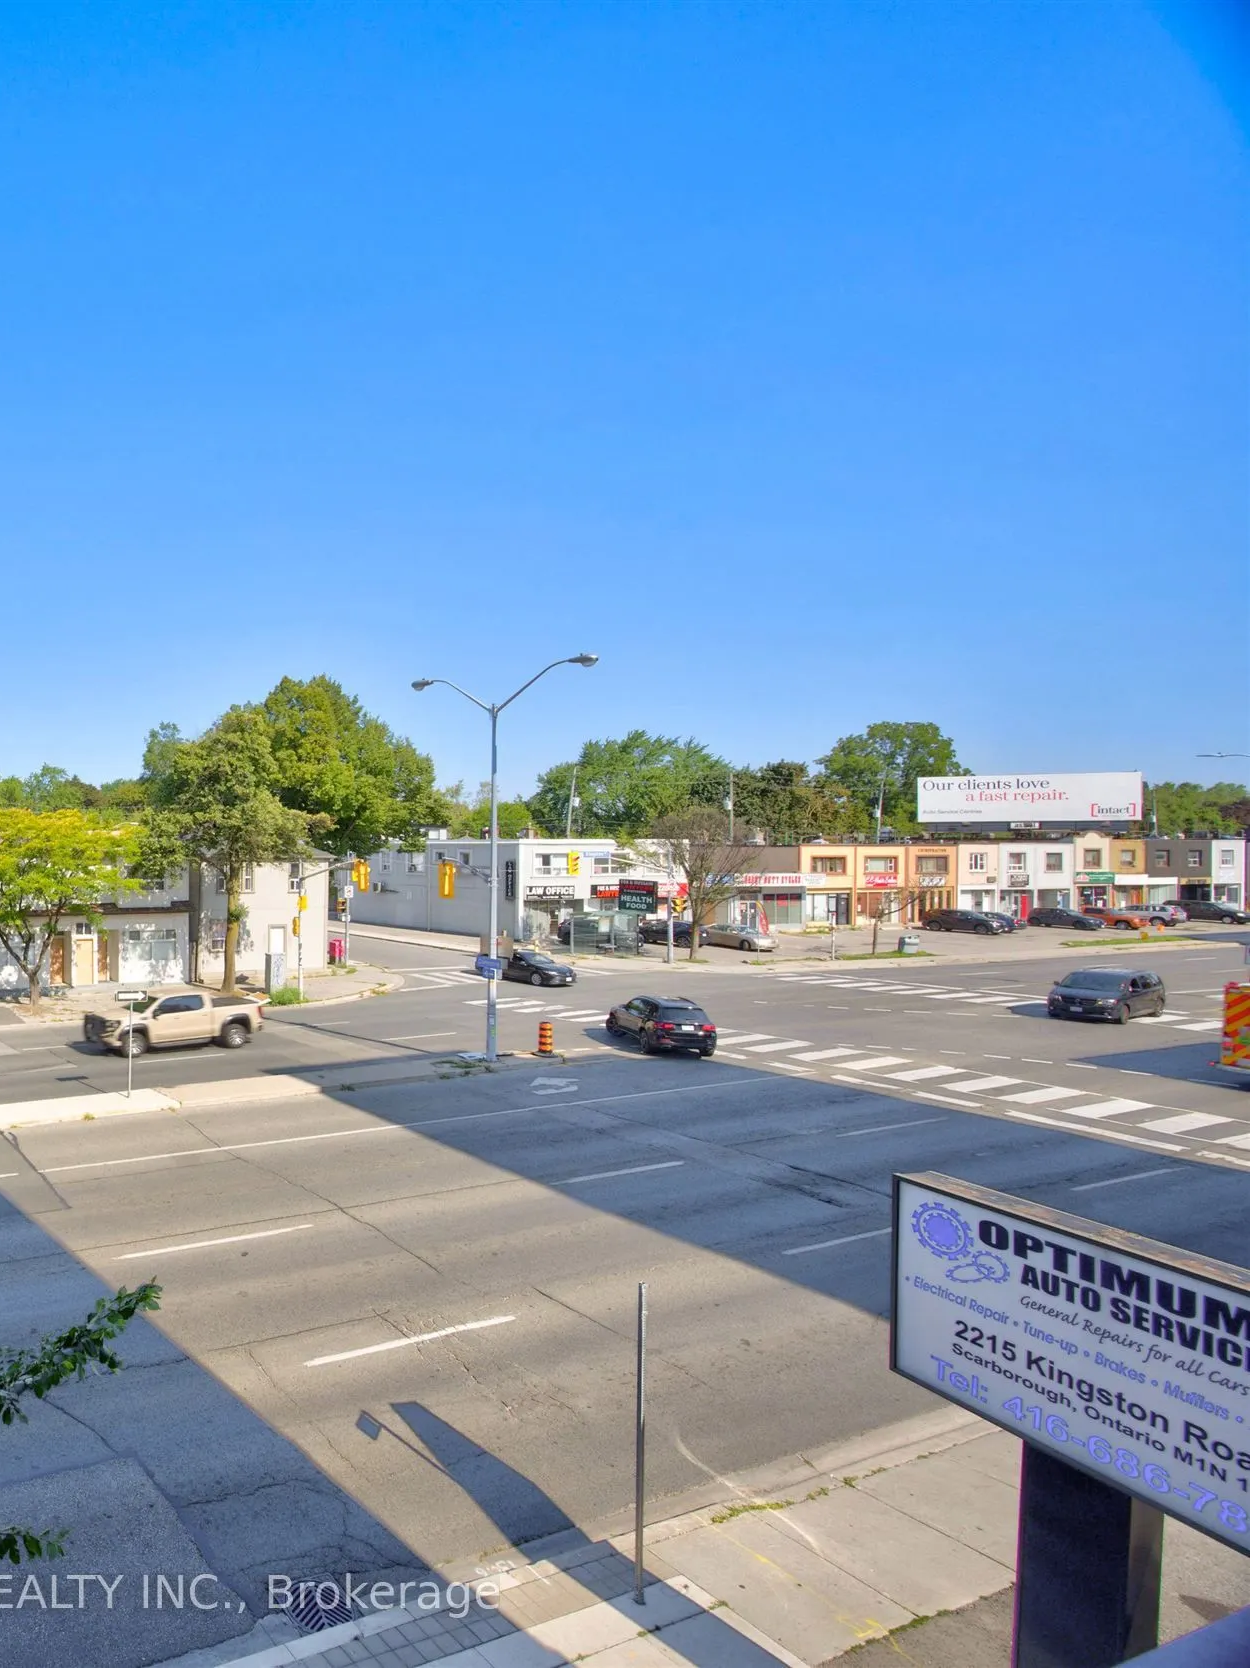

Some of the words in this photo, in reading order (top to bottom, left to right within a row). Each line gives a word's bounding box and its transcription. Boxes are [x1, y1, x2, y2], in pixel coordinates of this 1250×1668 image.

[922, 780, 954, 791] Our
[958, 778, 1012, 791] clients
[1016, 778, 1050, 790] love
[965, 793, 975, 802] a
[978, 791, 1009, 801] fast
[1013, 789, 1070, 804] repair.
[526, 886, 544, 895] LAW
[546, 886, 574, 895] OFFICE
[621, 894, 653, 903] HEALTH
[626, 902, 647, 910] FOOD
[978, 1219, 1250, 1342] OPTIMUM
[1020, 1264, 1102, 1313] AUTO
[913, 1276, 966, 1308] Electrical
[969, 1298, 1009, 1325] Repair
[1023, 1321, 1079, 1356] Tune-up
[1094, 1351, 1147, 1385] Brakes
[1163, 1380, 1230, 1421] Mufflers
[1020, 1295, 1081, 1327] General
[1082, 1319, 1144, 1354] Repairs
[1142, 1344, 1172, 1363] for
[1175, 1359, 1206, 1377] all
[1208, 1370, 1250, 1396] Cars
[930, 1354, 989, 1404] Tel:
[954, 1319, 1017, 1362] 2215
[1026, 1350, 1170, 1434] Kingston
[1183, 1419, 1250, 1471] Roa
[951, 1343, 1077, 1413] Scarborough,
[1084, 1405, 1166, 1452] Ontario
[1173, 1445, 1228, 1482] M1N
